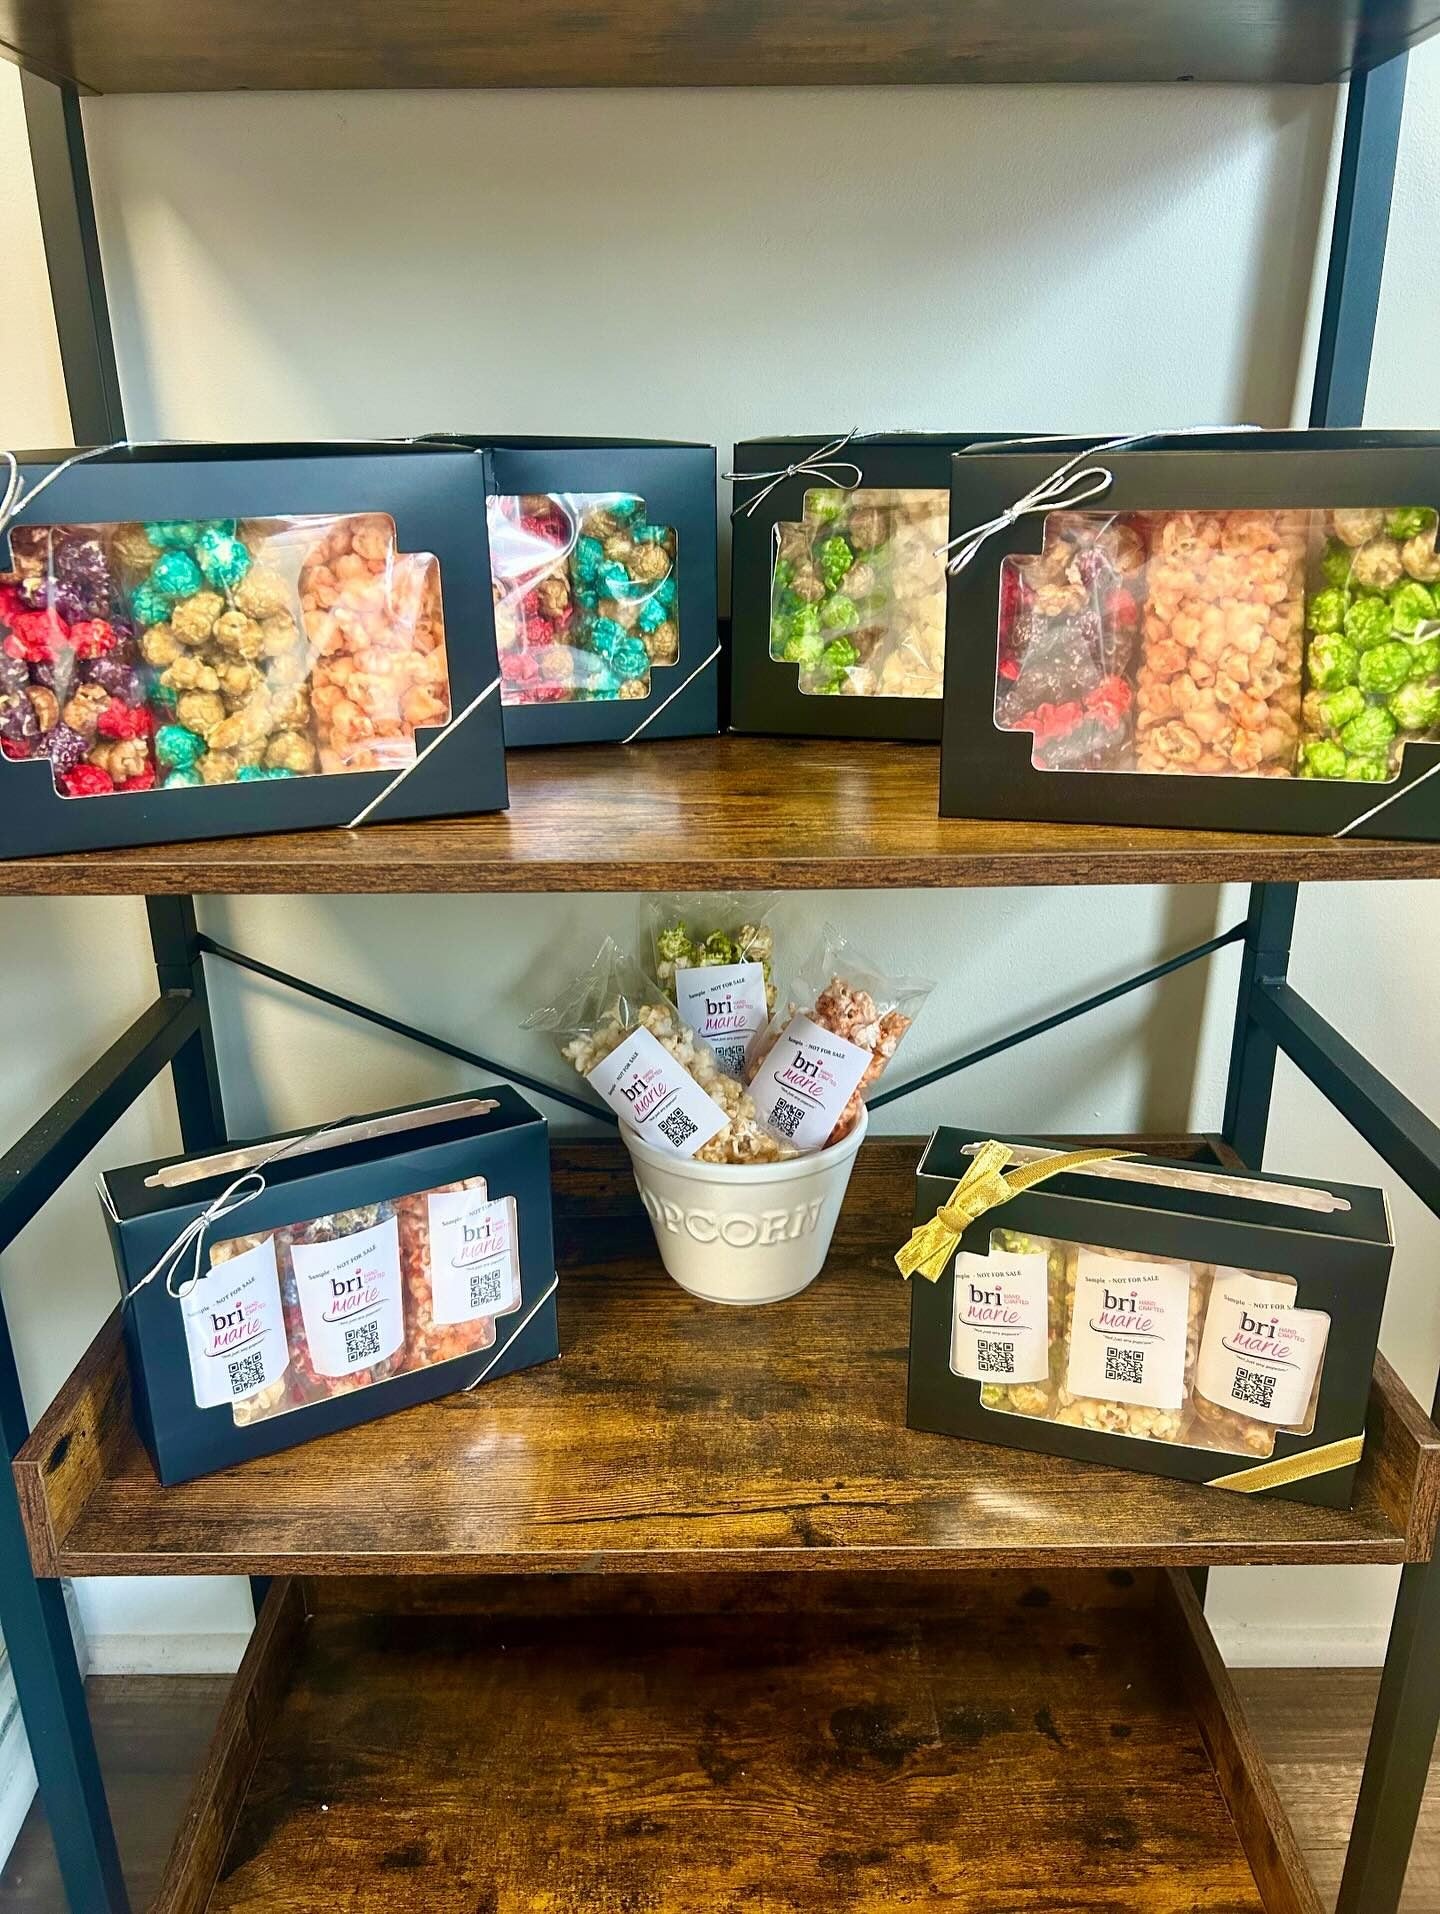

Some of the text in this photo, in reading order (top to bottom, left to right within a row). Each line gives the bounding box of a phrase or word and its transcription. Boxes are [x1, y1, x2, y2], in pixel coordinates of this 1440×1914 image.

[722, 981, 733, 989] FOR
[705, 994, 733, 1015] bri
[706, 1014, 747, 1030] marie
[793, 1050, 823, 1078] bri
[809, 1044, 820, 1052] NOT
[832, 1051, 846, 1059] SALE
[620, 1073, 648, 1101] bri
[783, 1068, 824, 1097] marie
[633, 1082, 668, 1115] marie
[463, 1217, 491, 1242] bri
[461, 1236, 504, 1260] marie
[308, 1245, 376, 1280] Sample NOT FOR SALE
[216, 1295, 229, 1304] NOT
[230, 1287, 241, 1297] FOR
[242, 1277, 255, 1287] SALE
[330, 1268, 363, 1296] bri
[1085, 1276, 1105, 1284] Sample
[332, 1286, 379, 1314] marie
[970, 1284, 1002, 1306] bri
[1104, 1289, 1138, 1313] bri
[1224, 1294, 1245, 1305] Sample
[1254, 1302, 1269, 1310] NOT
[211, 1301, 244, 1331] bri
[967, 1305, 1021, 1323] marie
[1099, 1311, 1153, 1331] marie
[1241, 1312, 1279, 1338] bri
[214, 1319, 261, 1348] marie
[1233, 1332, 1293, 1358] marie
